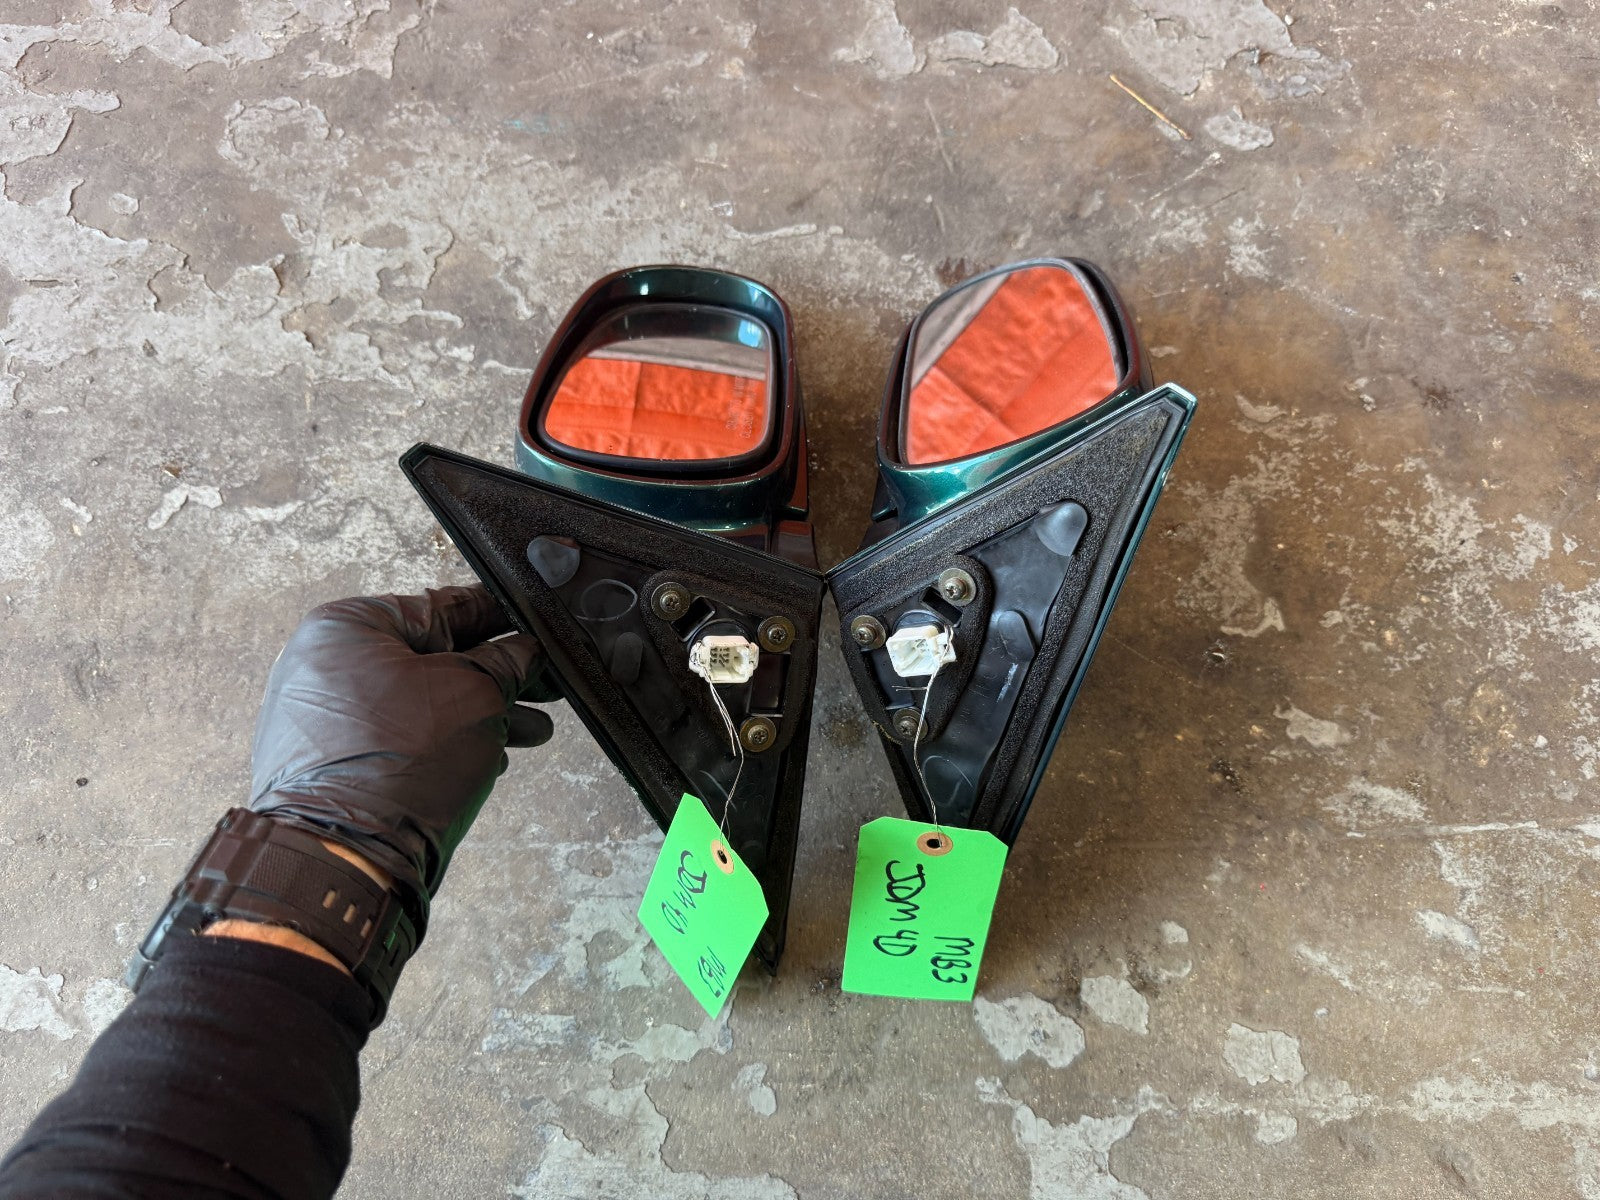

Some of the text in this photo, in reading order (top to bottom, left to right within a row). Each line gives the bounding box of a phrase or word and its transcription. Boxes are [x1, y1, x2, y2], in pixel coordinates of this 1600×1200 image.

[673, 850, 708, 909] JDM
[872, 860, 926, 957] JDM 4D
[930, 936, 976, 984] MB3
